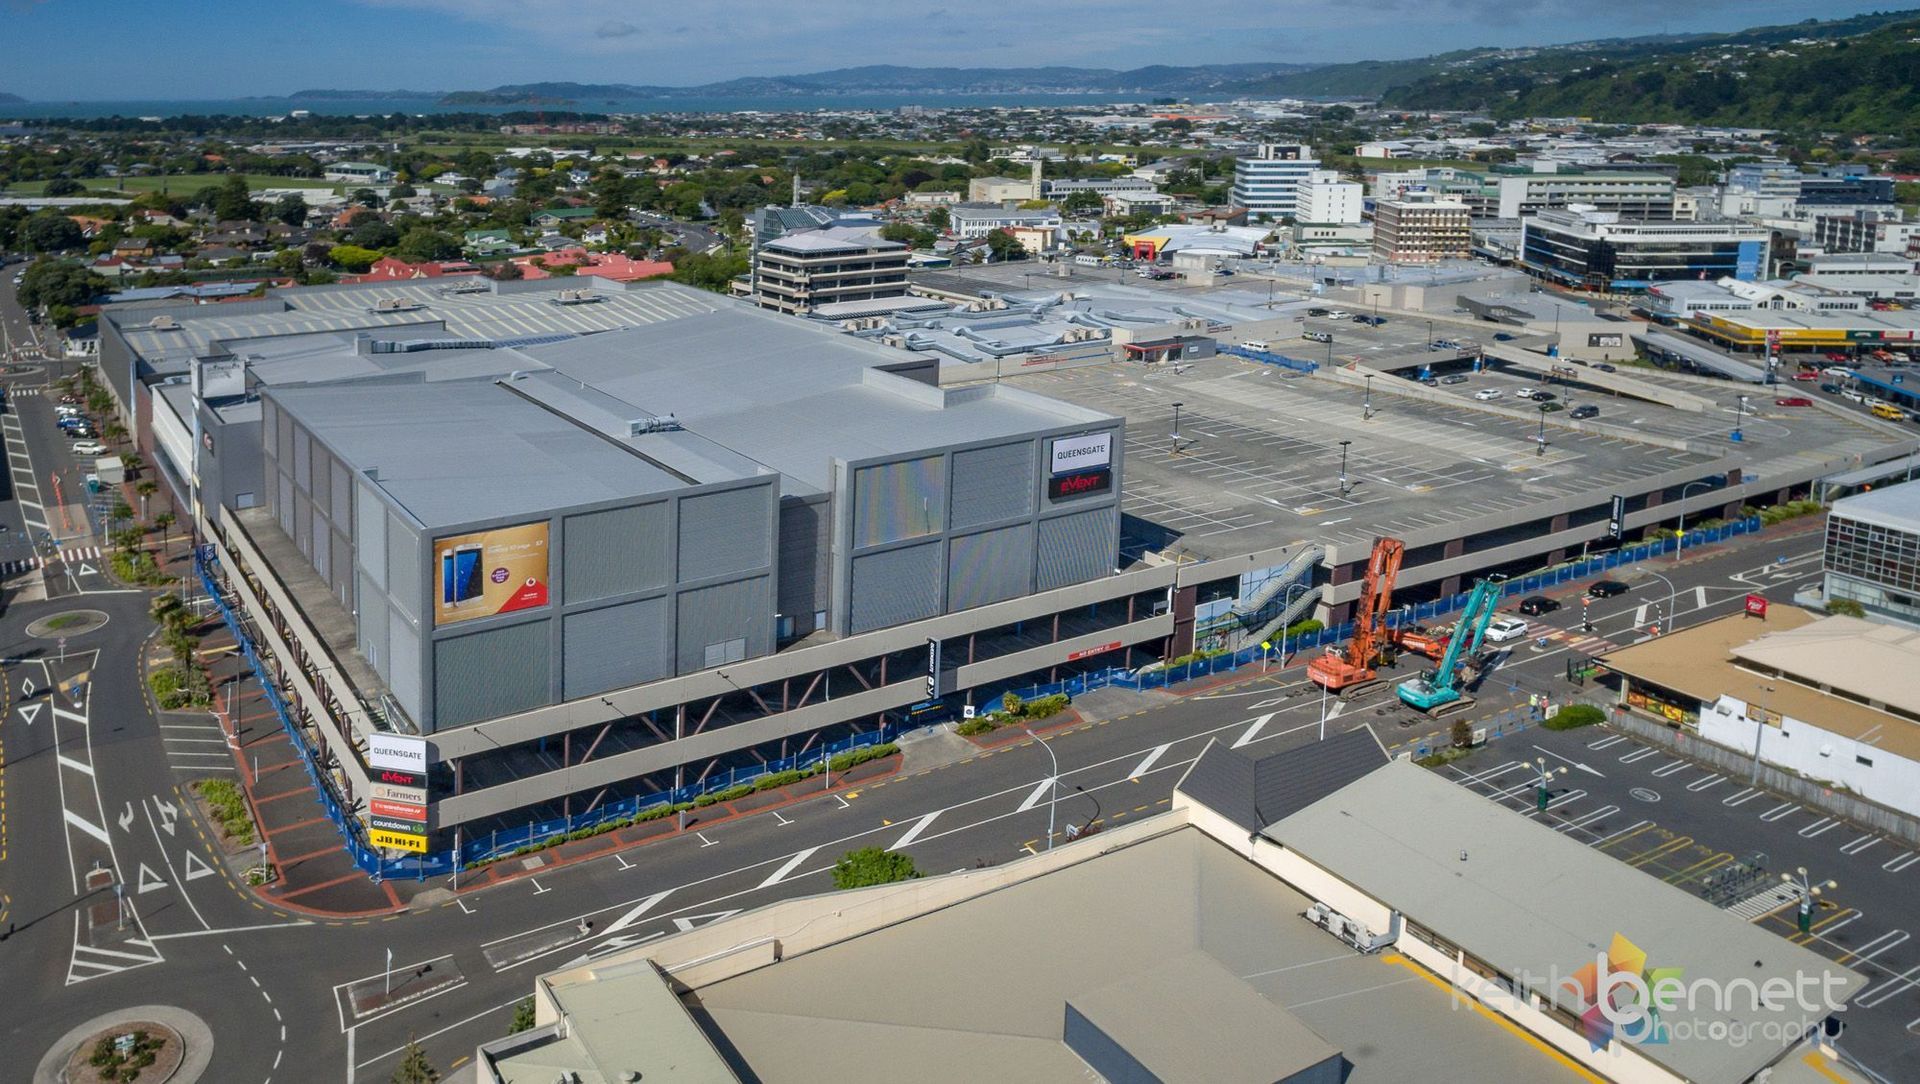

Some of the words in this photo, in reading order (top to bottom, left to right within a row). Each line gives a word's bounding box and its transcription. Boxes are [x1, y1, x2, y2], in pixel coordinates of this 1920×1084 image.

[1057, 445, 1105, 460] QUEENSGATE
[373, 747, 423, 760] QUEENSGATE
[386, 788, 422, 801] Farmers
[372, 820, 411, 831] countdown
[376, 836, 393, 844] JB
